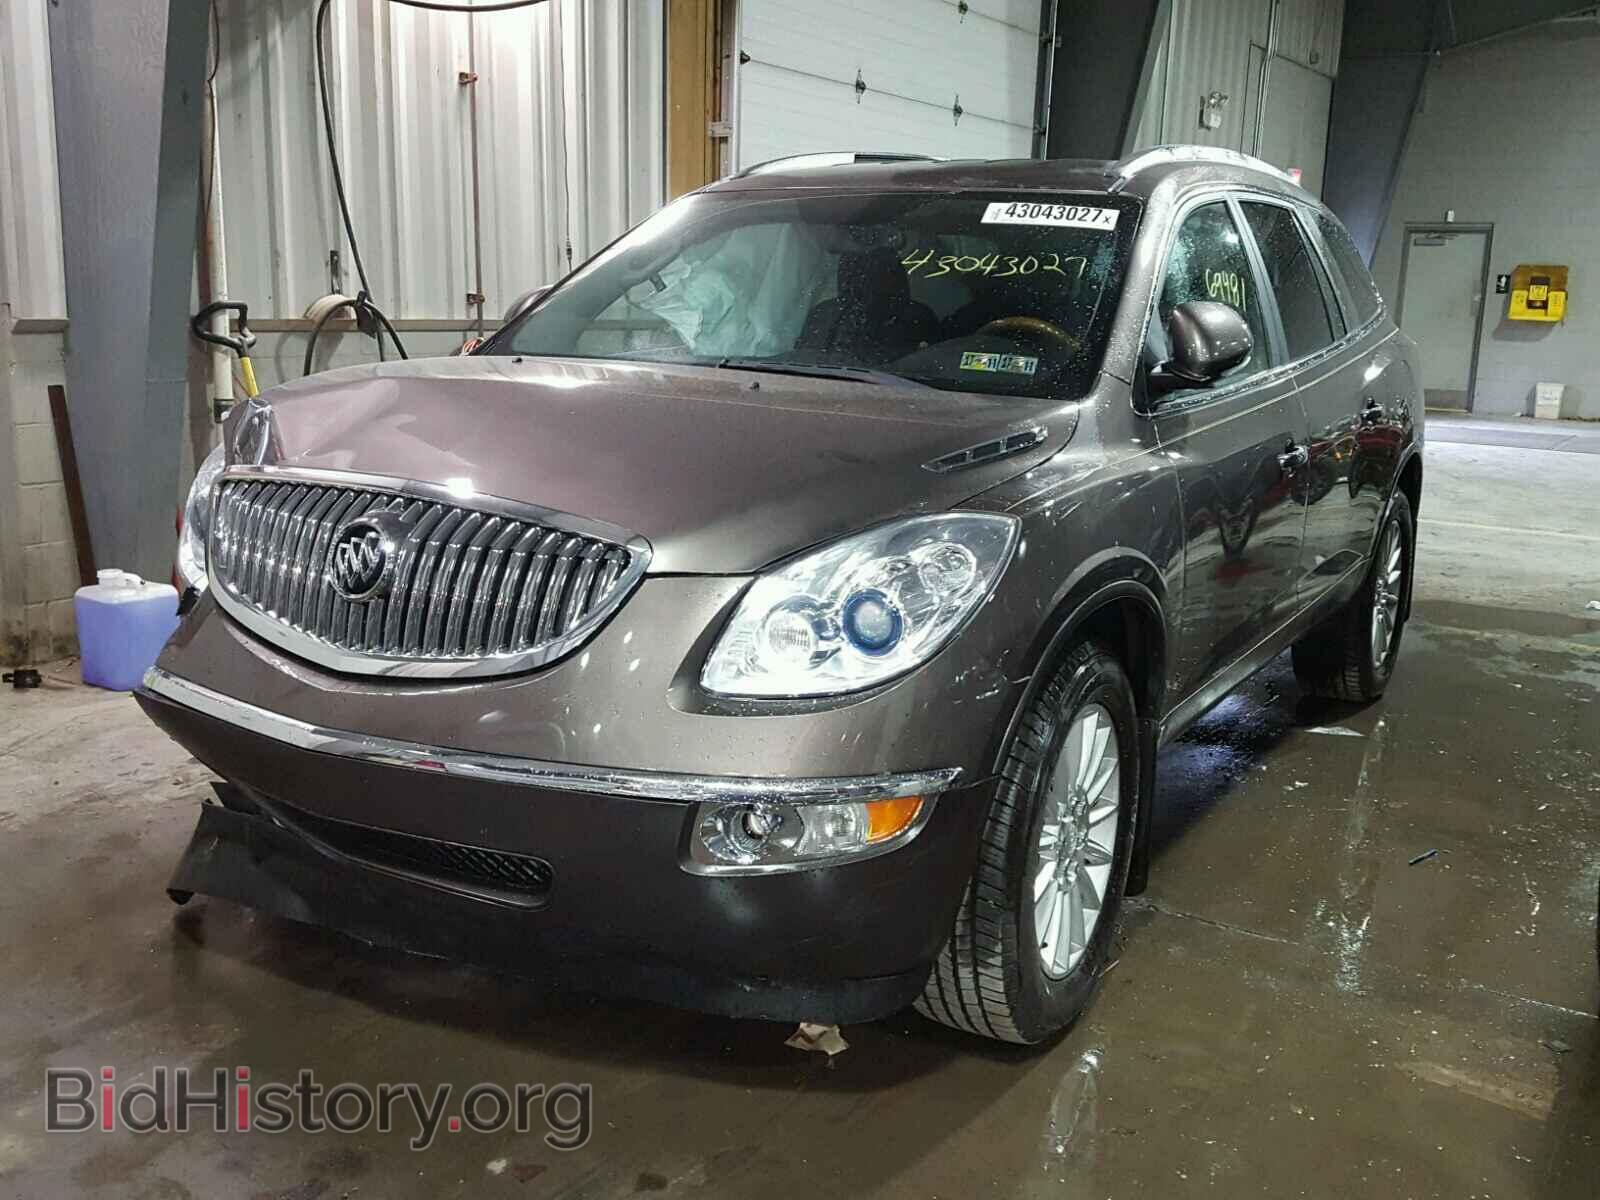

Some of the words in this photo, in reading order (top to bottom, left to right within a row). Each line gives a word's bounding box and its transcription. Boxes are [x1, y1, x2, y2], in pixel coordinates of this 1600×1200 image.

[1005, 203, 1102, 222] 43043027
[901, 249, 1087, 278] 43043027
[1205, 268, 1247, 313] 69481
